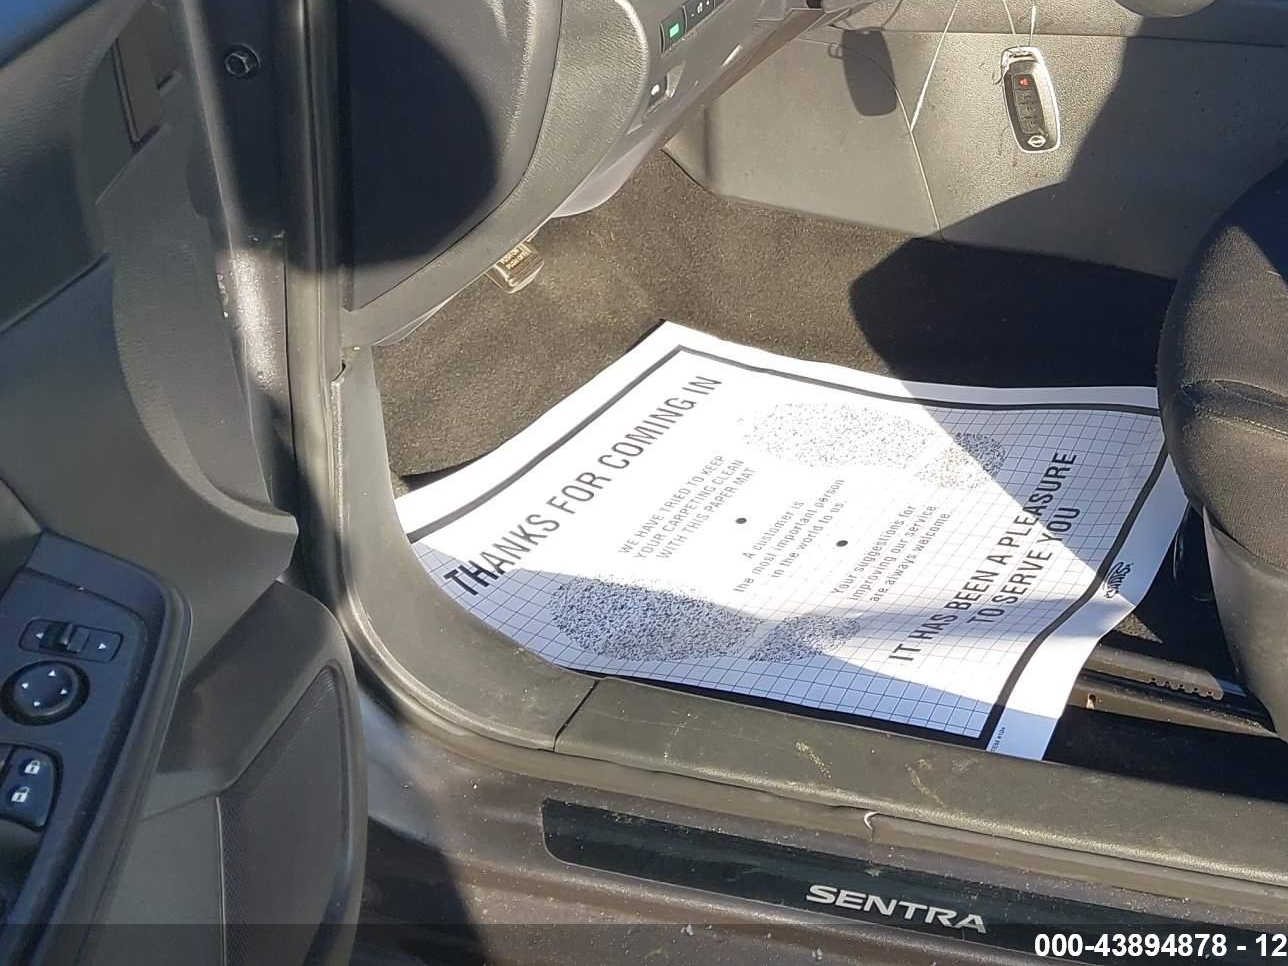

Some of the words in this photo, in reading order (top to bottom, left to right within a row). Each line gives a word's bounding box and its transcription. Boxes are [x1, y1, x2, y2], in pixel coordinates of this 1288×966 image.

[443, 512, 560, 596] THANKS
[546, 471, 612, 515] FOR
[597, 396, 697, 470] COMING
[681, 375, 723, 395] IN
[618, 538, 639, 554] WE
[634, 514, 664, 538] HAVE
[659, 487, 691, 513] TRIED
[686, 476, 705, 487] TO
[701, 455, 724, 475] KEEP
[634, 532, 665, 559] YOUR
[662, 484, 717, 532] CARPETING
[711, 459, 745, 485] CLEAN
[656, 535, 688, 559] WITH
[682, 513, 710, 534] THIS
[703, 485, 738, 513] PAPER
[732, 467, 756, 486] MAT
[775, 508, 818, 552] important
[814, 478, 845, 509] person
[997, 451, 1078, 549] PLEASURE
[742, 551, 756, 560] A
[753, 510, 794, 552] customer
[791, 501, 805, 510] is
[771, 569, 785, 578] in
[779, 551, 800, 567] the
[796, 524, 825, 551] world
[818, 514, 834, 524] to
[830, 572, 858, 595] Your
[854, 519, 905, 573] suggestions
[898, 505, 917, 520] for
[847, 555, 898, 601] improving
[890, 537, 909, 555] our
[905, 505, 938, 537] service
[966, 607, 1006, 625] TO
[991, 549, 1053, 605] SERVE
[1041, 507, 1081, 542] YOU
[986, 553, 1013, 566] A
[884, 553, 917, 586] always
[946, 569, 1000, 611] BEEN
[888, 643, 921, 662] IT
[907, 613, 958, 640] HAS
[805, 883, 987, 934] SENTRA
